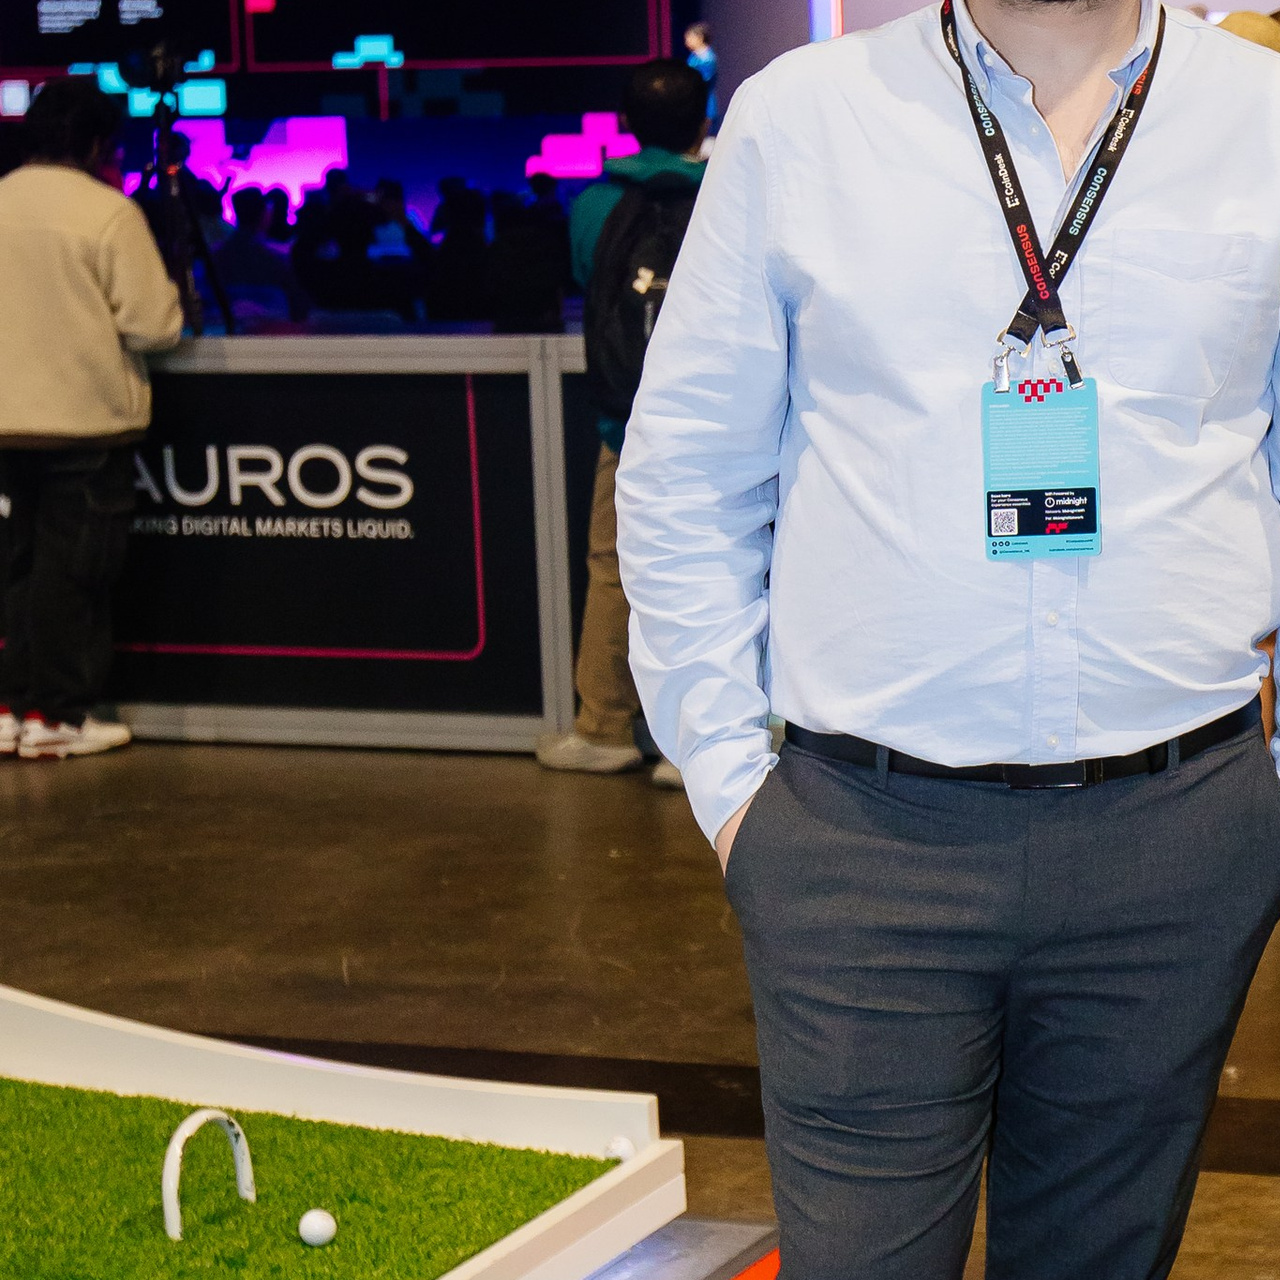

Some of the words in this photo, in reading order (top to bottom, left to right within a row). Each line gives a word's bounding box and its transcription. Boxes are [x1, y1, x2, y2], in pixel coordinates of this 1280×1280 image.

[1107, 116, 1129, 152] CoinDesk
[994, 153, 1015, 196] CoinDesk
[1069, 167, 1107, 236] CONSENSUS
[1016, 224, 1050, 300] CONSENSUS
[1056, 496, 1088, 507] midnight
[182, 515, 253, 537] DIGITAL
[255, 516, 344, 538] MARKETS
[347, 518, 415, 540] LIQUID.
